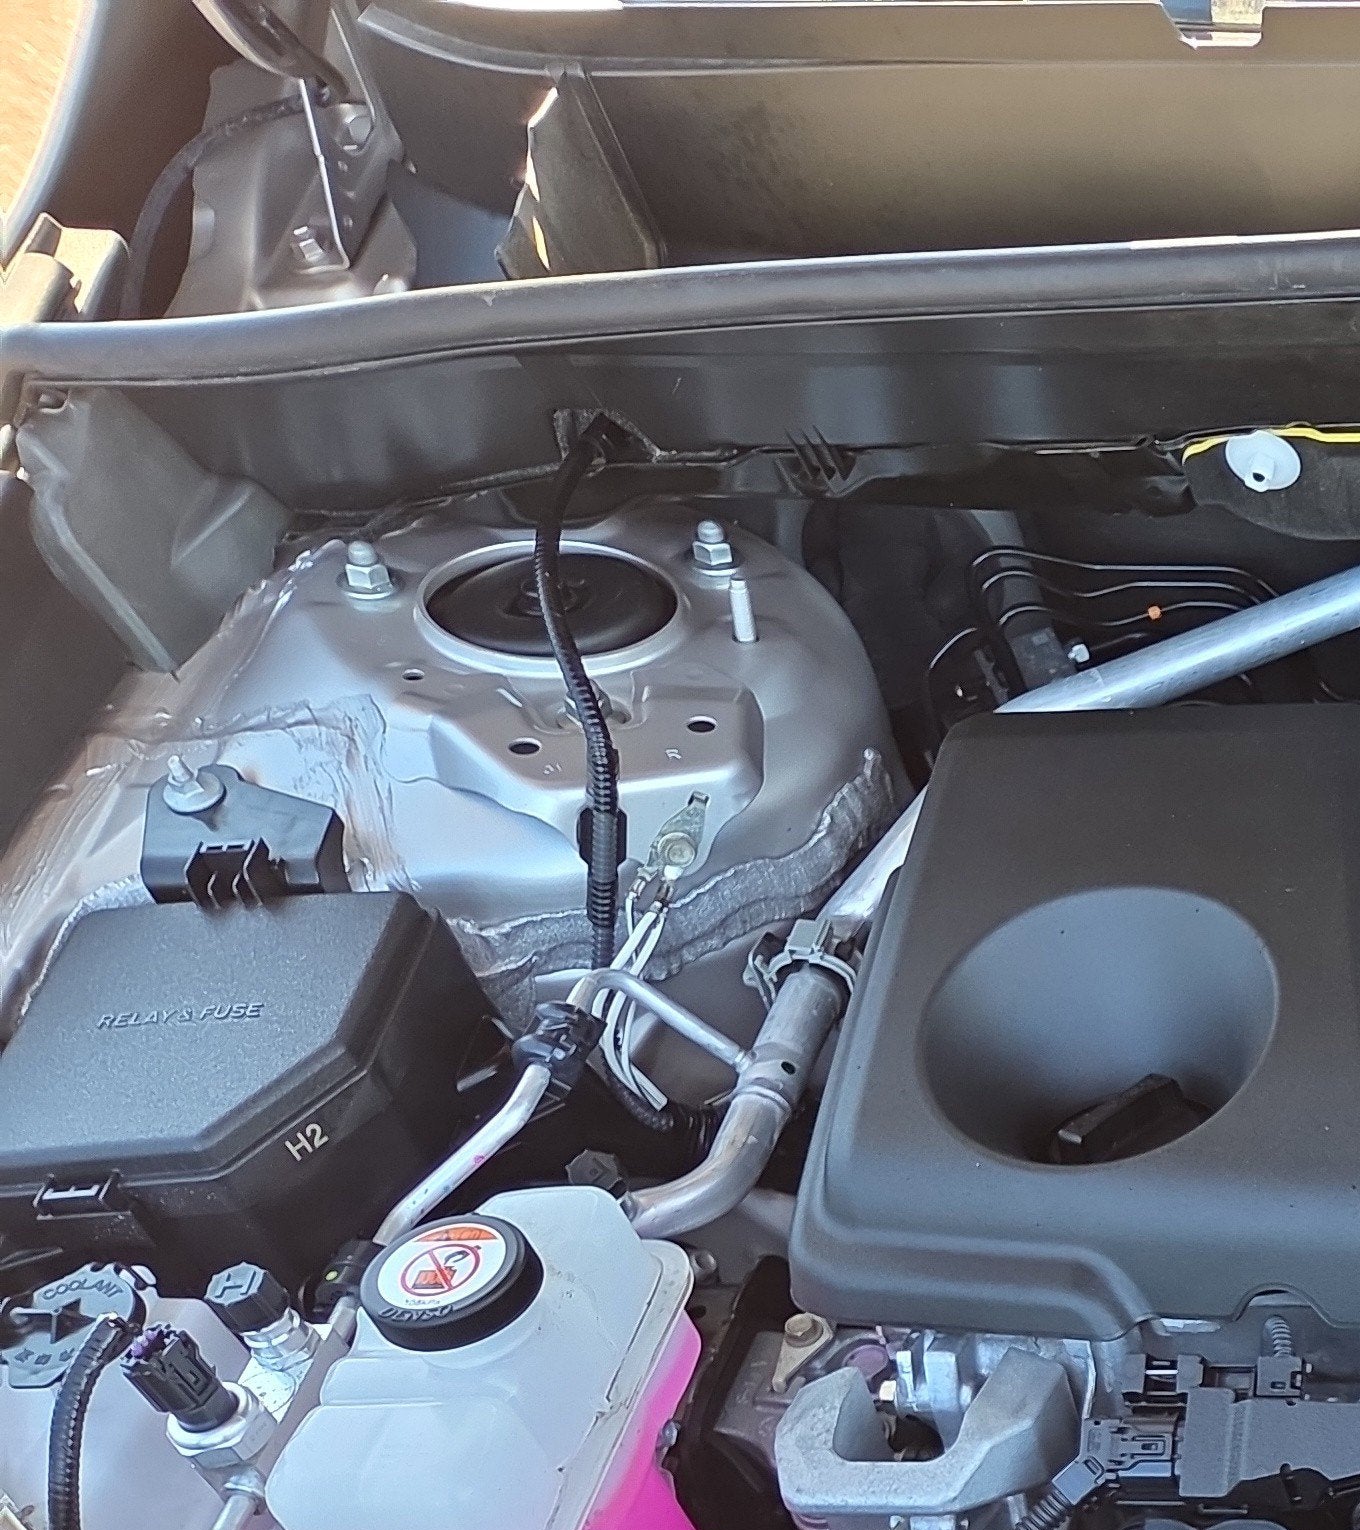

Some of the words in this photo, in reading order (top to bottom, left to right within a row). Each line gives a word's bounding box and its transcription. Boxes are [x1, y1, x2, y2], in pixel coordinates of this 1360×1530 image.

[96, 1009, 176, 1030] RELAY
[200, 1002, 264, 1021] FUSE
[284, 1123, 330, 1161] H2
[43, 1278, 124, 1300] COOLANT
